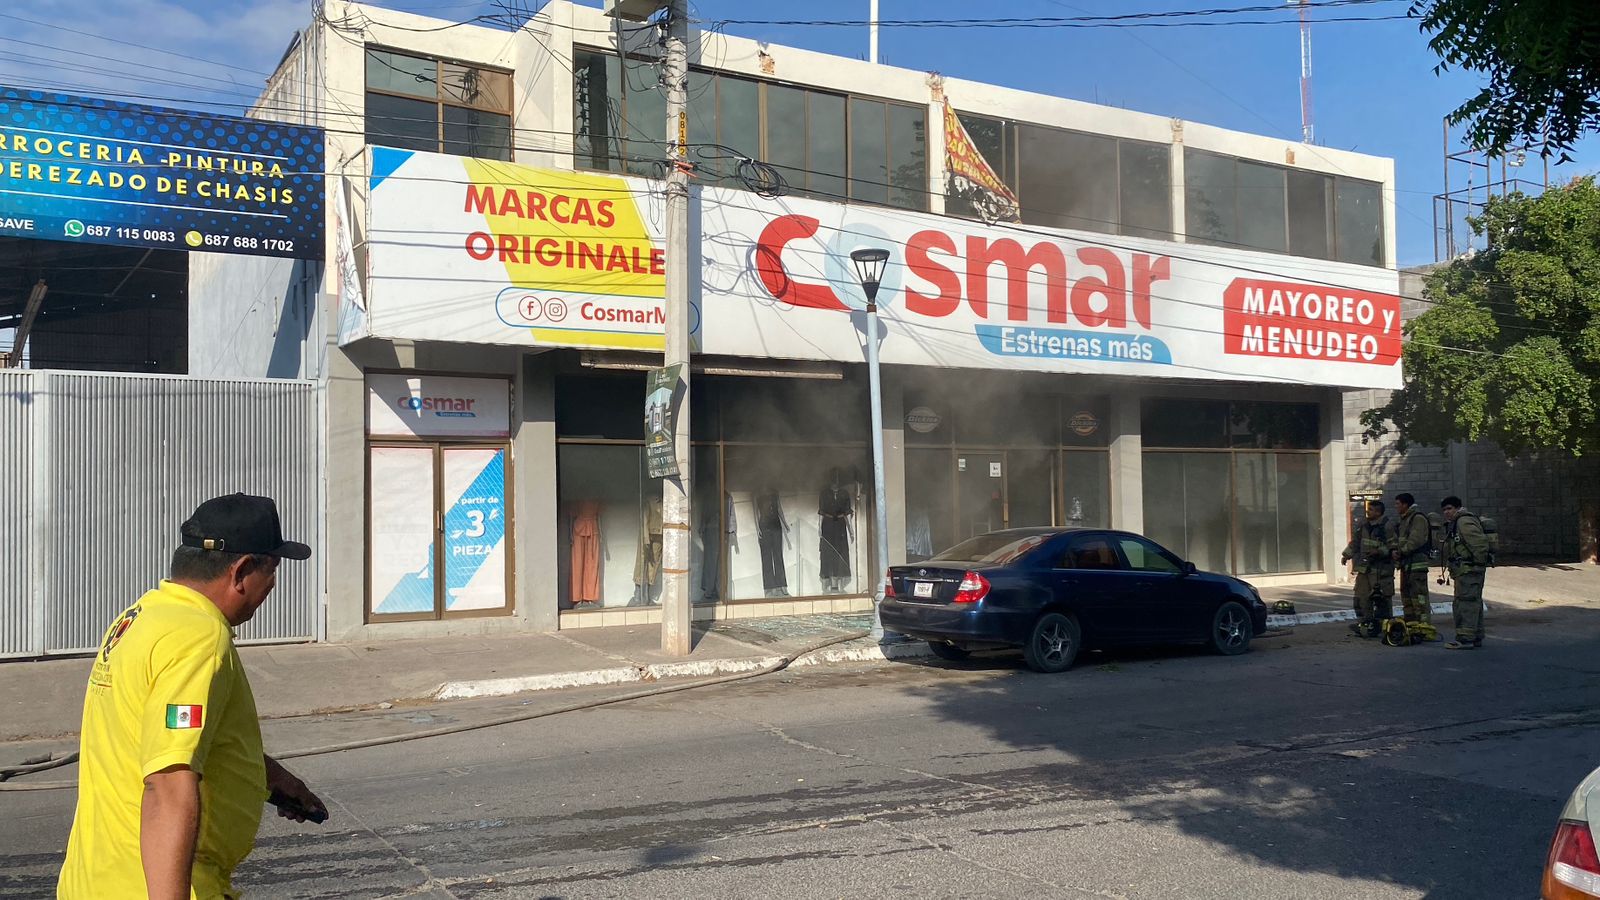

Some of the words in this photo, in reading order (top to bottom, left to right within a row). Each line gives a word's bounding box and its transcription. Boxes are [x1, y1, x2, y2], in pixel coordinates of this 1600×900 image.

[0, 162, 147, 190] EREZADO
[157, 177, 187, 195] DE
[197, 181, 293, 204] CHASIS
[464, 184, 615, 228] MARCAS
[87, 225, 111, 237] 687
[117, 227, 139, 239] 115
[143, 229, 175, 242] 0083
[204, 234, 229, 247] 687
[233, 236, 258, 249] 688
[262, 238, 294, 252] 1702
[465, 231, 665, 275] ORIGINALE
[1241, 287, 1375, 325] MAYOREO
[1001, 327, 1101, 358] Estrenas
[1108, 334, 1153, 361] más
[1241, 325, 1378, 361] MENUDEO
[461, 497, 486, 505] partir
[488, 496, 499, 504] de
[466, 510, 486, 538] 3
